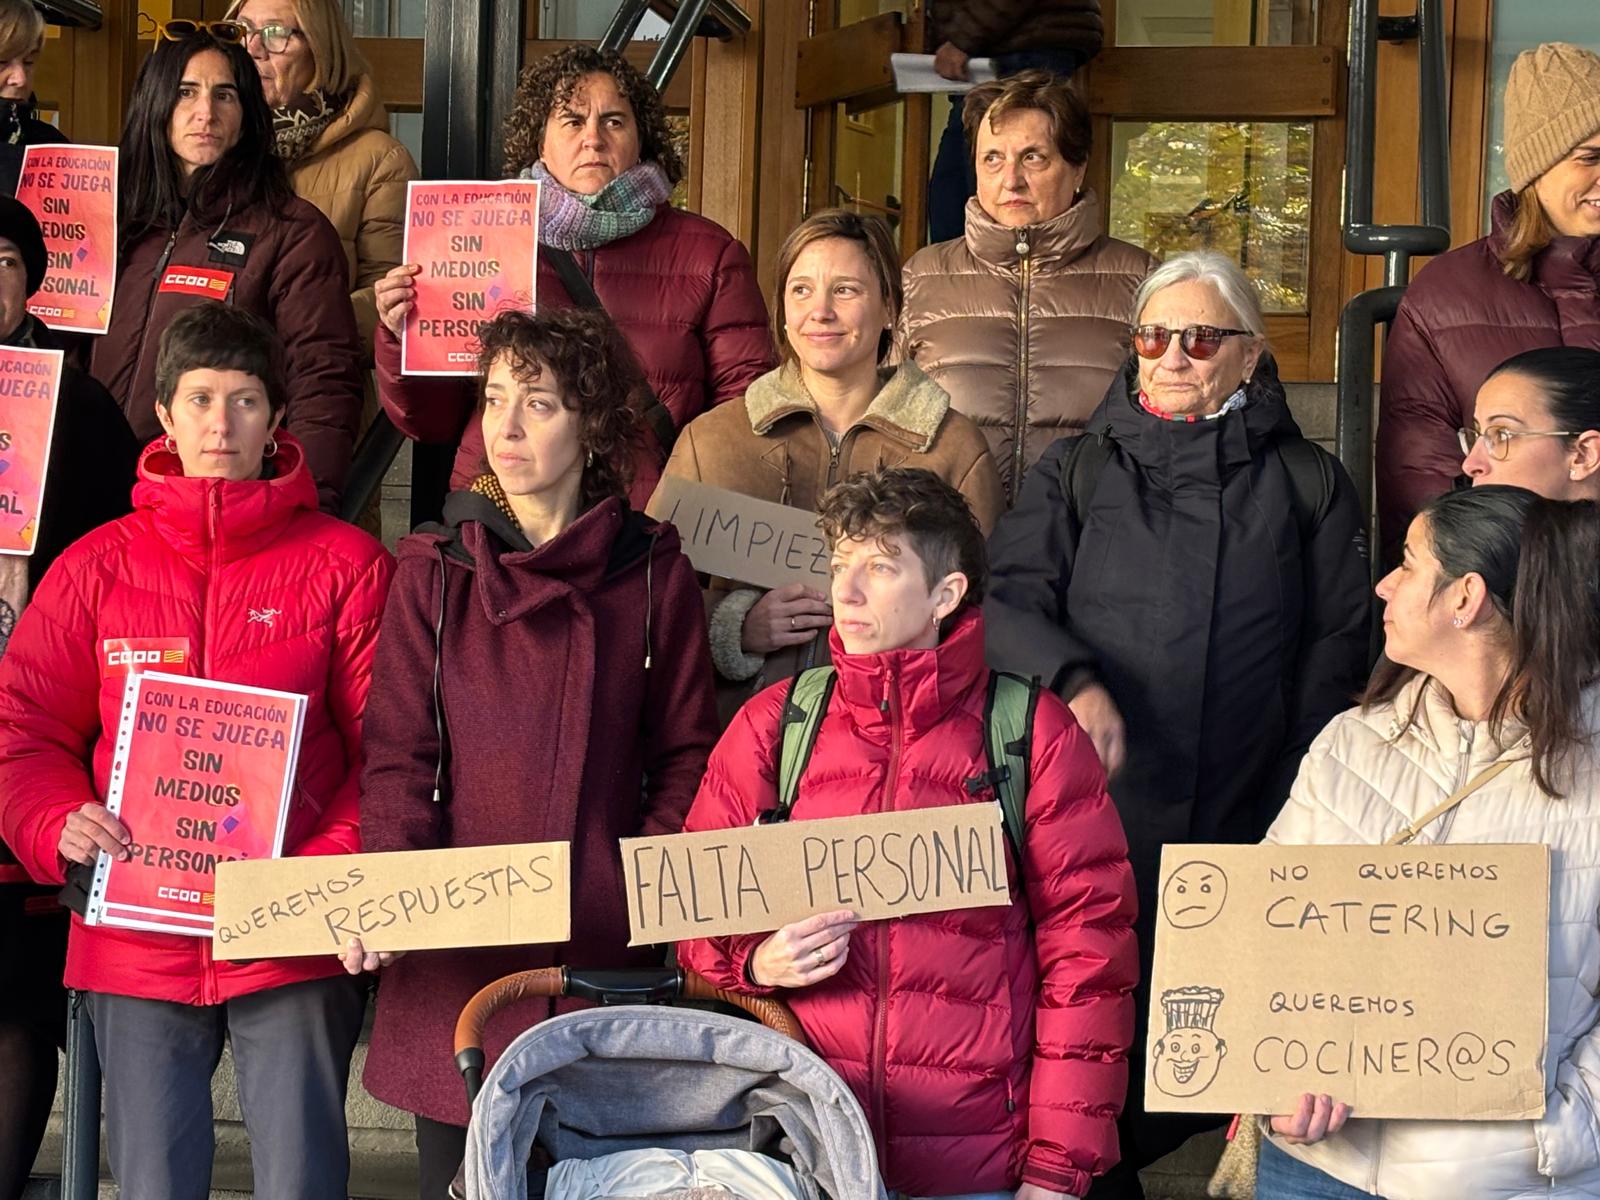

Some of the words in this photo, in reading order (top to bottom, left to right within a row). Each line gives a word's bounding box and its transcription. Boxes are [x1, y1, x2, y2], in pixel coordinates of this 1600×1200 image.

[41, 157, 53, 168] LA
[56, 157, 111, 171] EDUCACIÓN
[20, 172, 35, 188] NO
[38, 172, 56, 188] SE
[60, 173, 112, 193] JUEGA
[43, 196, 70, 215] SIN
[416, 193, 439, 206] CON
[443, 193, 459, 204] LA
[464, 189, 531, 205] EDUCACIÓN
[412, 210, 435, 227] NO
[441, 209, 464, 226] SE
[471, 209, 532, 226] JUEGA
[42, 221, 86, 241] EDIOS
[450, 235, 482, 252] SIN
[47, 251, 73, 270] SIN
[431, 260, 500, 278] MEDIOS
[43, 275, 99, 297] SONAL
[165, 274, 209, 287] CCOO
[29, 305, 62, 317] CCOO
[452, 291, 485, 311] SIN
[419, 319, 482, 338] PERSO
[0, 378, 50, 400] UEGA
[107, 650, 161, 665] CCOO
[144, 691, 174, 708] CON
[179, 695, 199, 711] LA
[205, 699, 287, 724] EDUCACIÓN
[138, 711, 167, 733] NO
[175, 716, 205, 739] SE
[212, 721, 285, 750] JUEGA
[183, 749, 223, 774] SIN
[154, 776, 241, 807] MEDIOS
[176, 817, 218, 842] SIN
[128, 842, 246, 875] PERSON
[633, 844, 770, 929] FALTA
[802, 824, 1007, 908] PERSONAL
[1270, 865, 1309, 882] NO
[1358, 861, 1499, 881] QUEREMOS
[157, 886, 201, 903] CCOO
[324, 855, 554, 946] RESPUESTAS
[218, 867, 365, 944] QUEREMOS
[1265, 896, 1510, 939] CATERING
[1269, 991, 1415, 1017] QUEREMOS
[1253, 1031, 1516, 1082] COCINER@S
